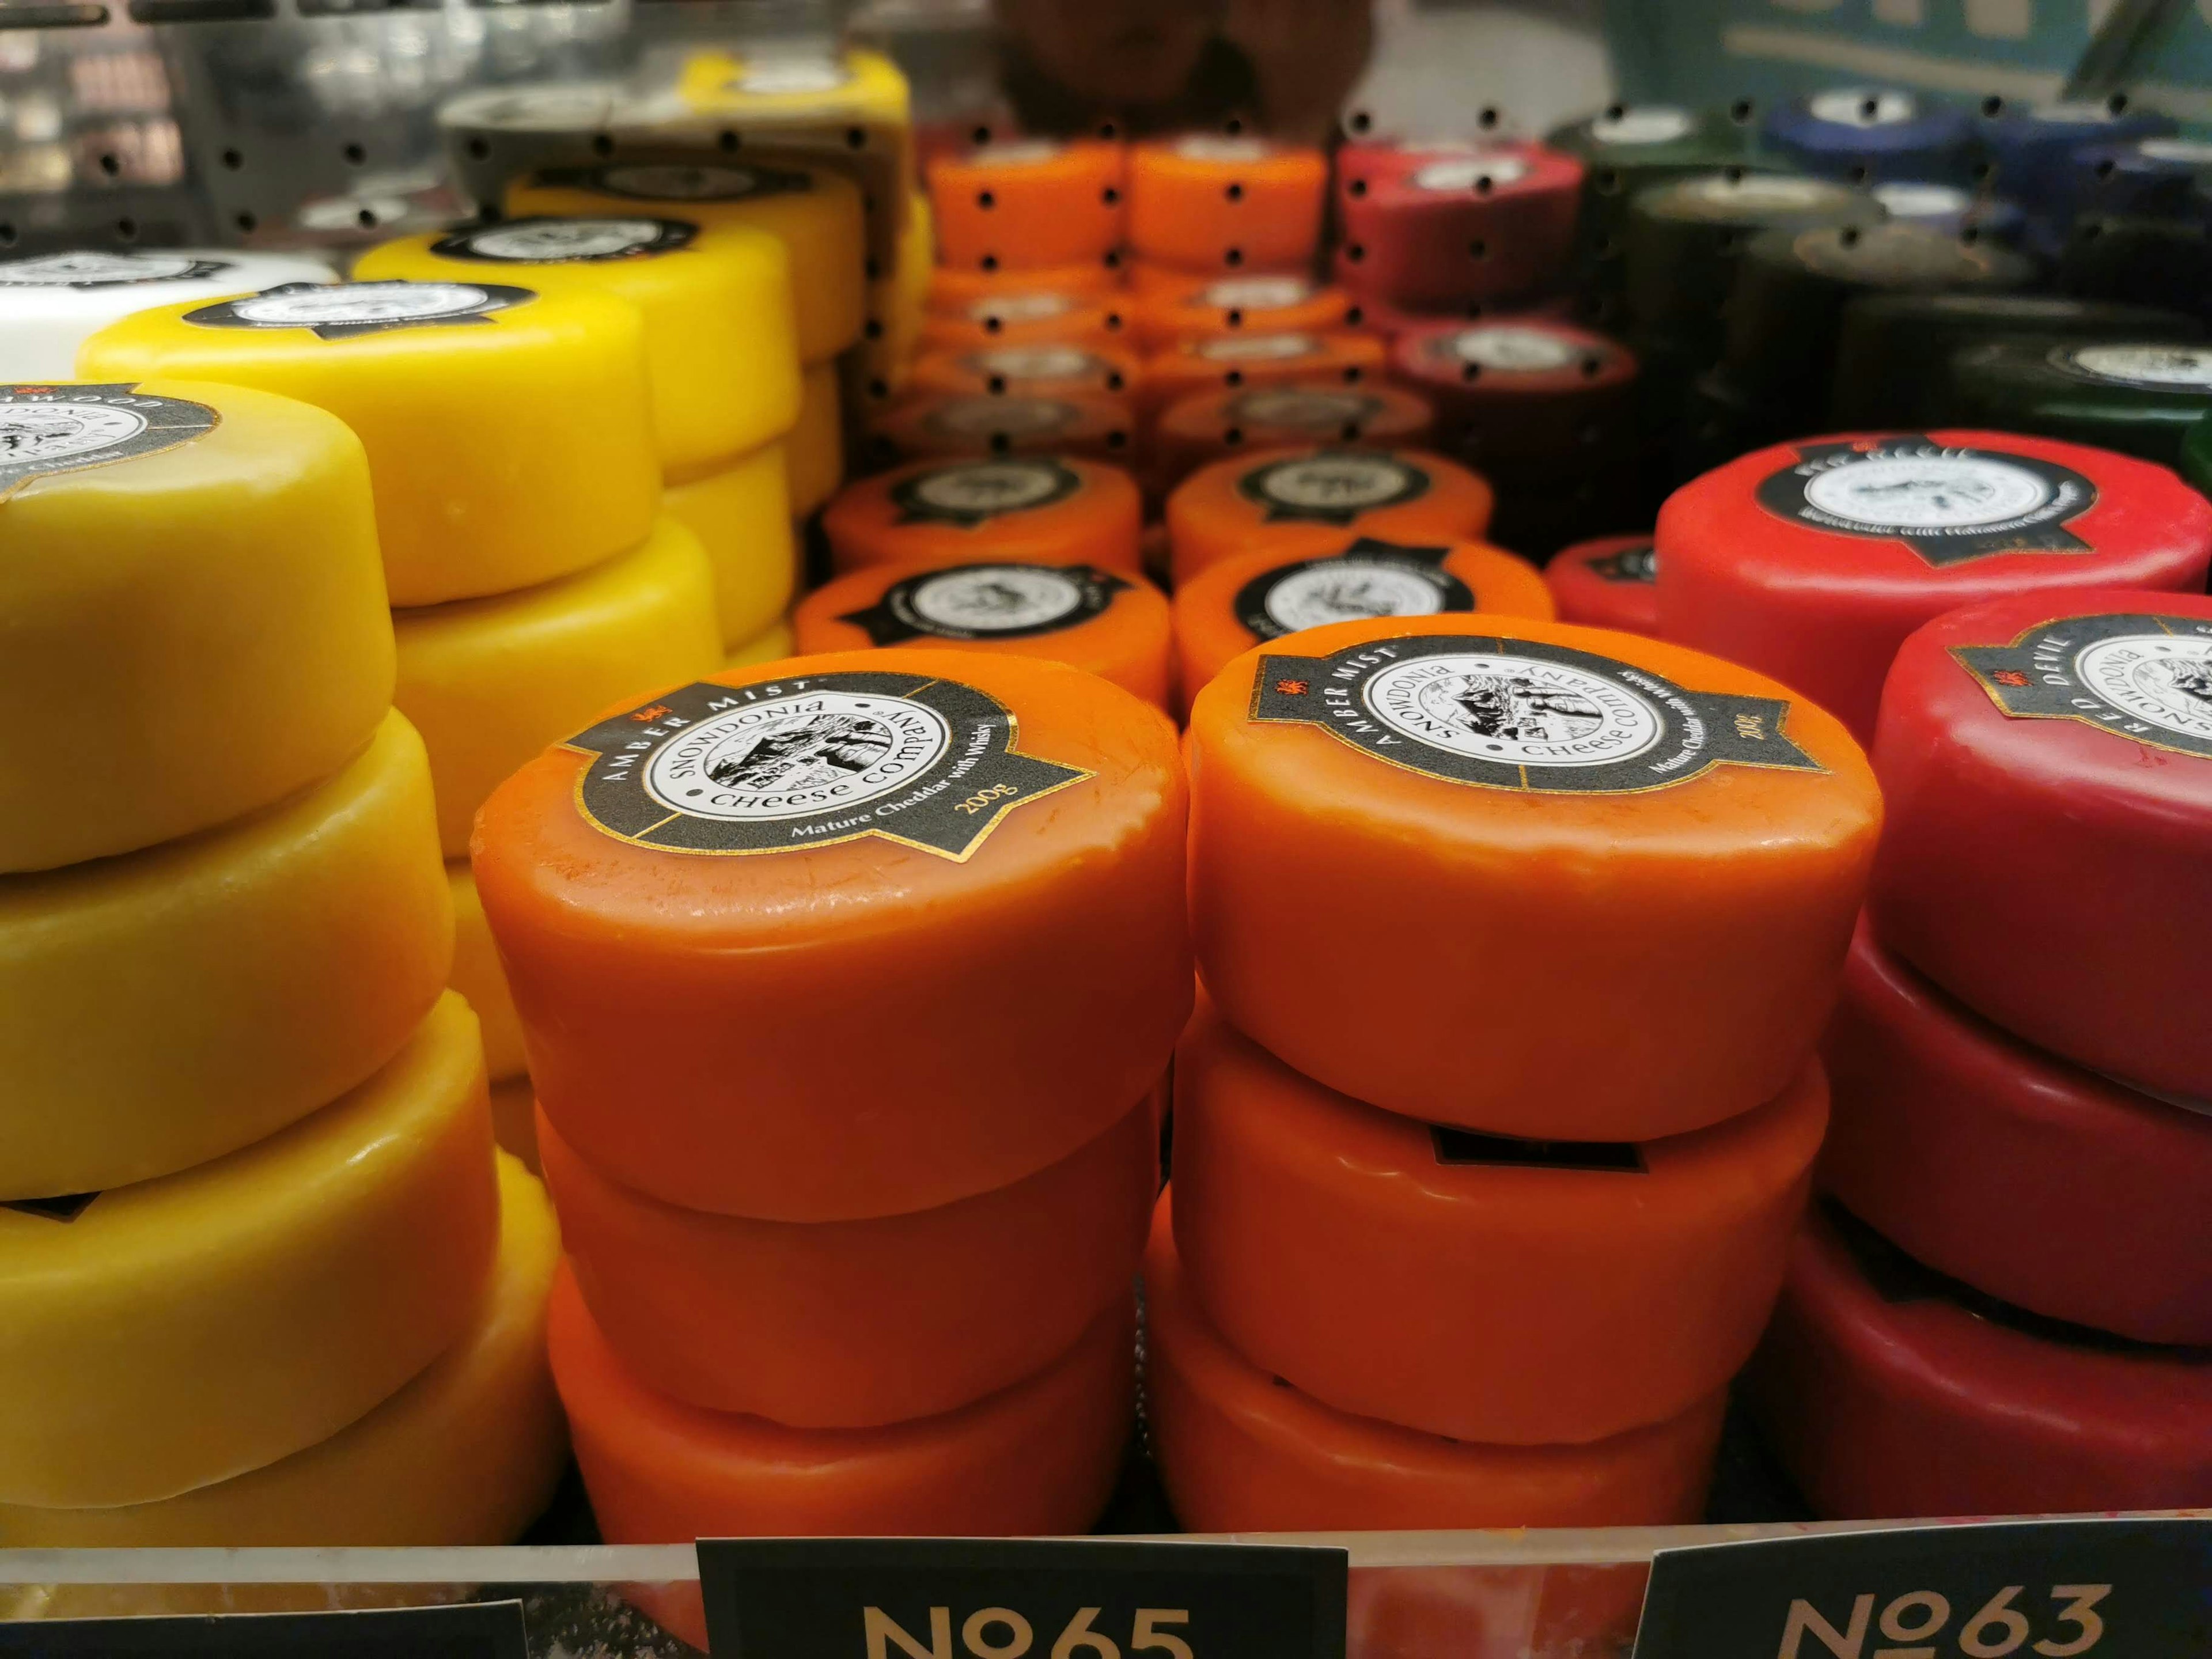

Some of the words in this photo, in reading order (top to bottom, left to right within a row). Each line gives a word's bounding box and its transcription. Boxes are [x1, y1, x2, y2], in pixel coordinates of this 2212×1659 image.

[1332, 646, 1397, 680] MIST
[2033, 635, 2071, 686] DEVIL
[1324, 688, 1402, 745] AMBER
[1665, 698, 1696, 717] with
[2071, 699, 2150, 733] RED
[603, 717, 691, 781] AMBER
[707, 680, 810, 711] MIST
[1681, 717, 1705, 749] Cheddar
[1734, 714, 1766, 740] 200g
[1648, 749, 1696, 774] Mature
[791, 813, 872, 838] Mature
[875, 779, 950, 816] Cheddar
[948, 752, 978, 779] with
[971, 724, 997, 757] Whisky
[955, 781, 1018, 815] 200g
